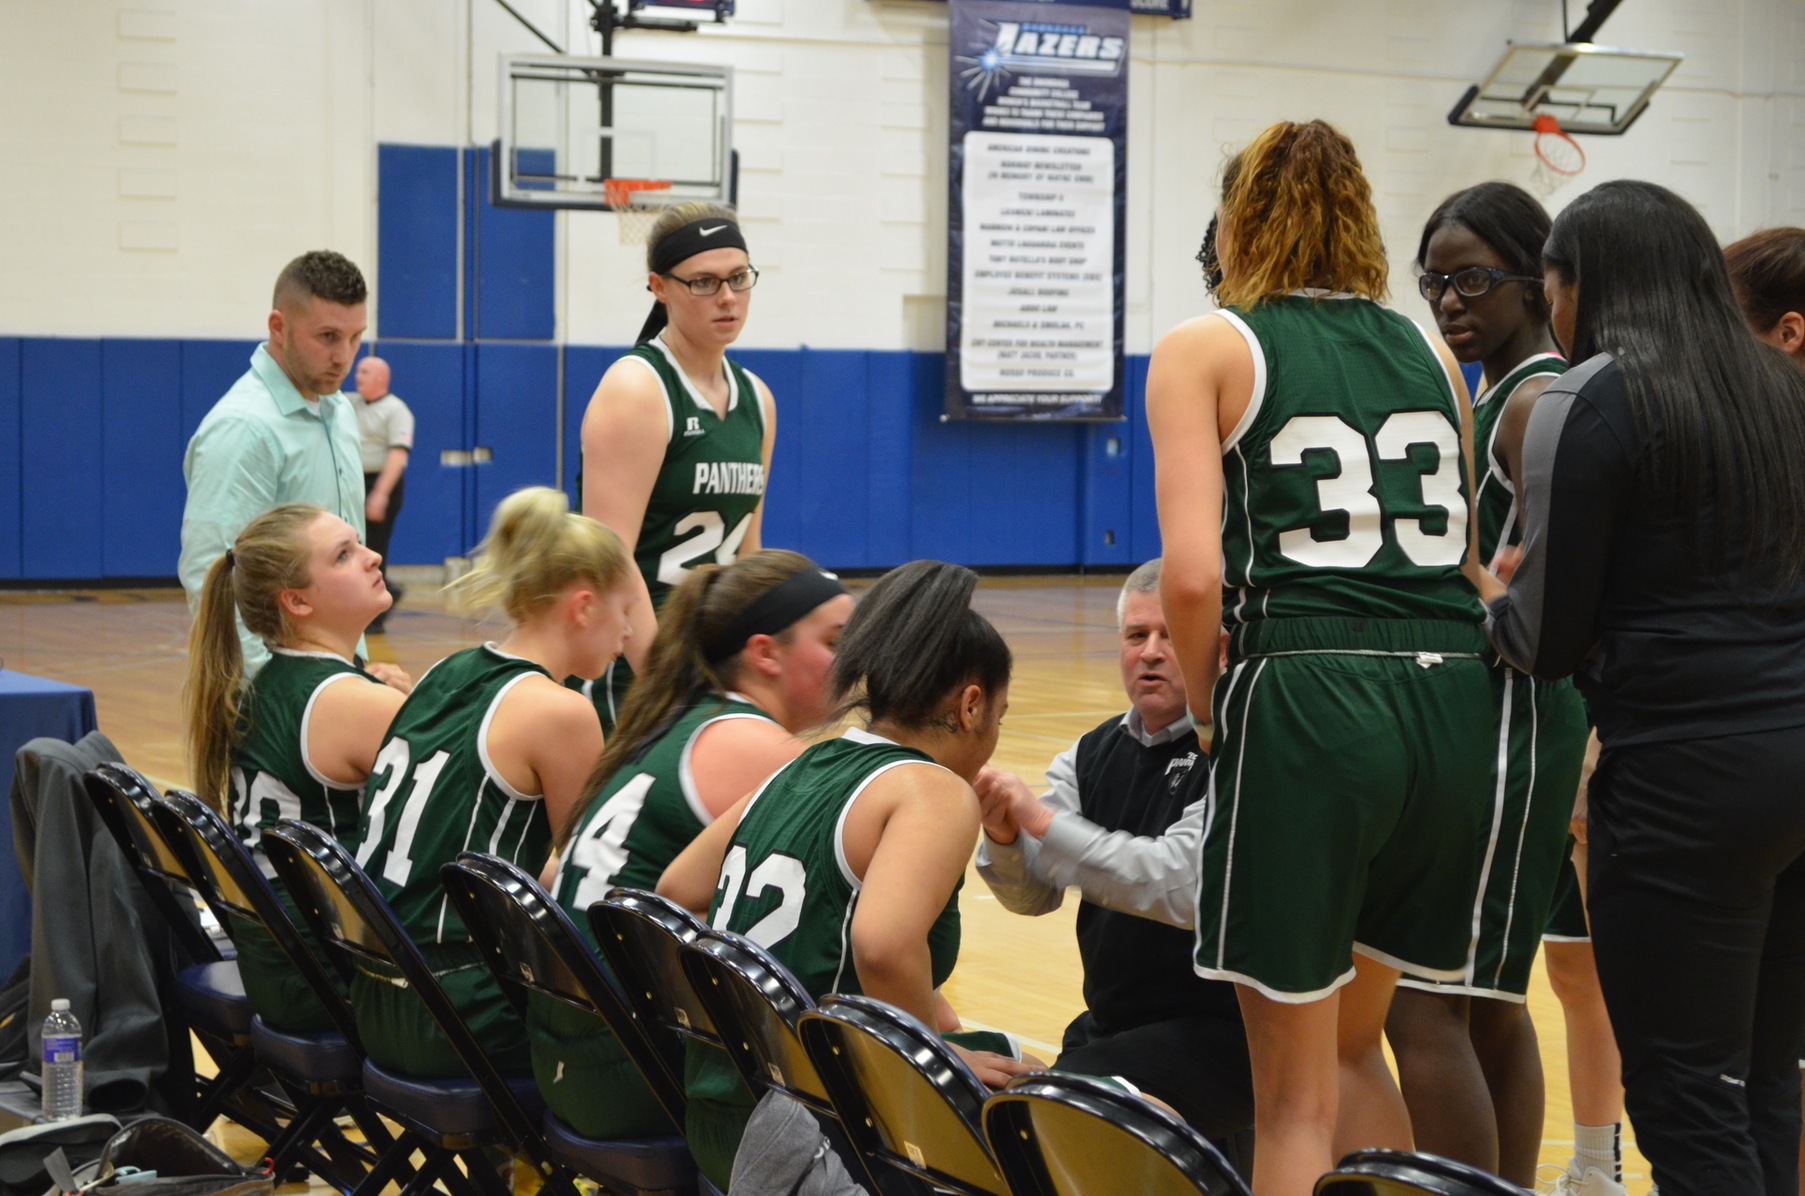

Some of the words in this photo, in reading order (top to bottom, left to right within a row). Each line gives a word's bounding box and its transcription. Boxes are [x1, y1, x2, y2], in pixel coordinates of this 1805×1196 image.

[996, 22, 1124, 59] LAZERS
[1270, 411, 1468, 568] 33
[355, 736, 450, 887] 31
